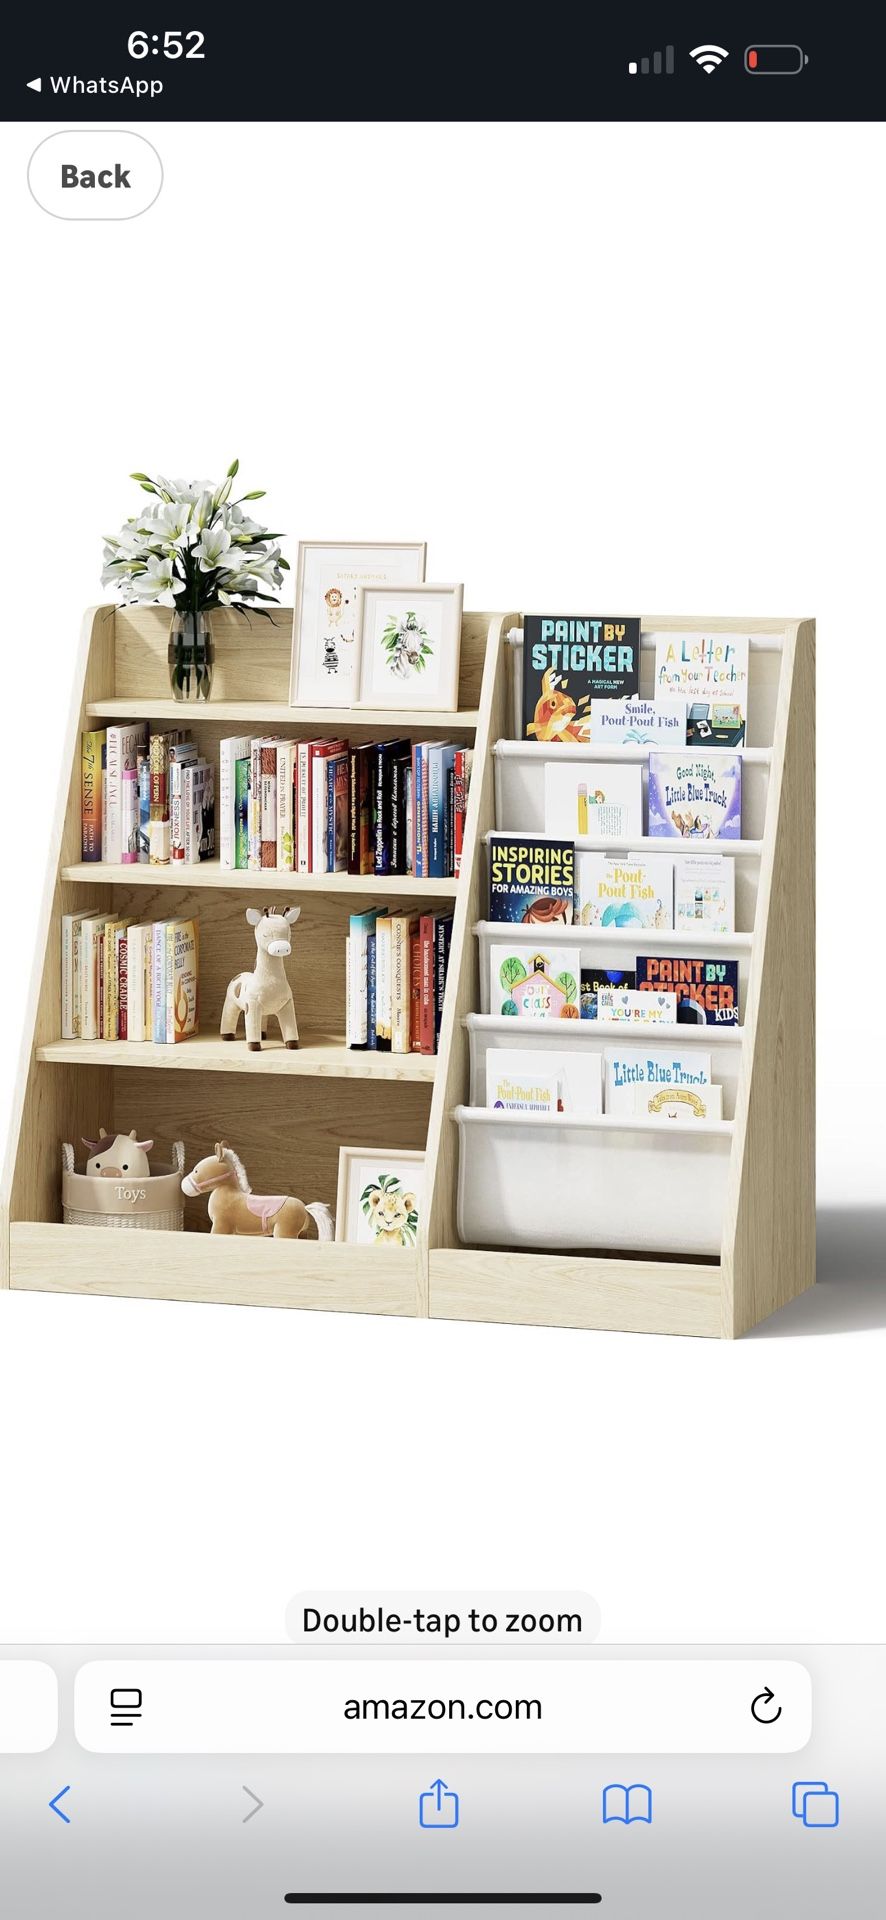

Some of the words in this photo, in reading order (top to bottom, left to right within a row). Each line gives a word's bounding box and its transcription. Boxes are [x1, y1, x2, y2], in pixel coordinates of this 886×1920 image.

[127, 30, 205, 60] 6:52
[49, 75, 164, 98] WhatsApp
[61, 163, 132, 189] Back
[541, 619, 602, 643] PAINT
[603, 623, 626, 641] BY
[531, 643, 634, 672] STICKER
[665, 642, 676, 663] A
[681, 638, 735, 664] Letter
[624, 702, 656, 715] Smile,
[600, 714, 654, 727] Pout-Pout
[657, 716, 680, 728] Fish
[279, 757, 287, 785] UNITED
[676, 763, 694, 780] Good
[83, 777, 95, 815] SENSE
[279, 793, 287, 819] PRAYER
[664, 785, 686, 807] Little
[687, 782, 704, 802] Blue
[704, 782, 727, 809] Truck
[375, 829, 385, 856] Zeppelin
[376, 857, 384, 868] Led
[492, 845, 574, 866] INSPIRING
[492, 862, 574, 886] STORIES
[491, 883, 509, 894] FOR
[509, 884, 550, 896] AMAZING
[550, 886, 574, 897] BOYS
[598, 882, 625, 898] Pout
[630, 884, 655, 899] Fish
[119, 942, 128, 975] COSMIC
[155, 954, 162, 963] OF
[412, 943, 421, 987] CHOICES
[646, 958, 704, 983] PAINT
[705, 963, 726, 983] BY
[119, 976, 128, 1011] CRADLE
[611, 1008, 646, 1018] YOU'RE
[648, 1010, 663, 1019] MY
[714, 1006, 739, 1022] KIDS
[613, 1061, 645, 1087] Little
[646, 1060, 671, 1083] Blue
[114, 1185, 147, 1204] Toys
[303, 1606, 461, 1639] Double-tap
[467, 1608, 498, 1633] to
[505, 1613, 582, 1633] zoom
[343, 1697, 542, 1720] amazon.com
